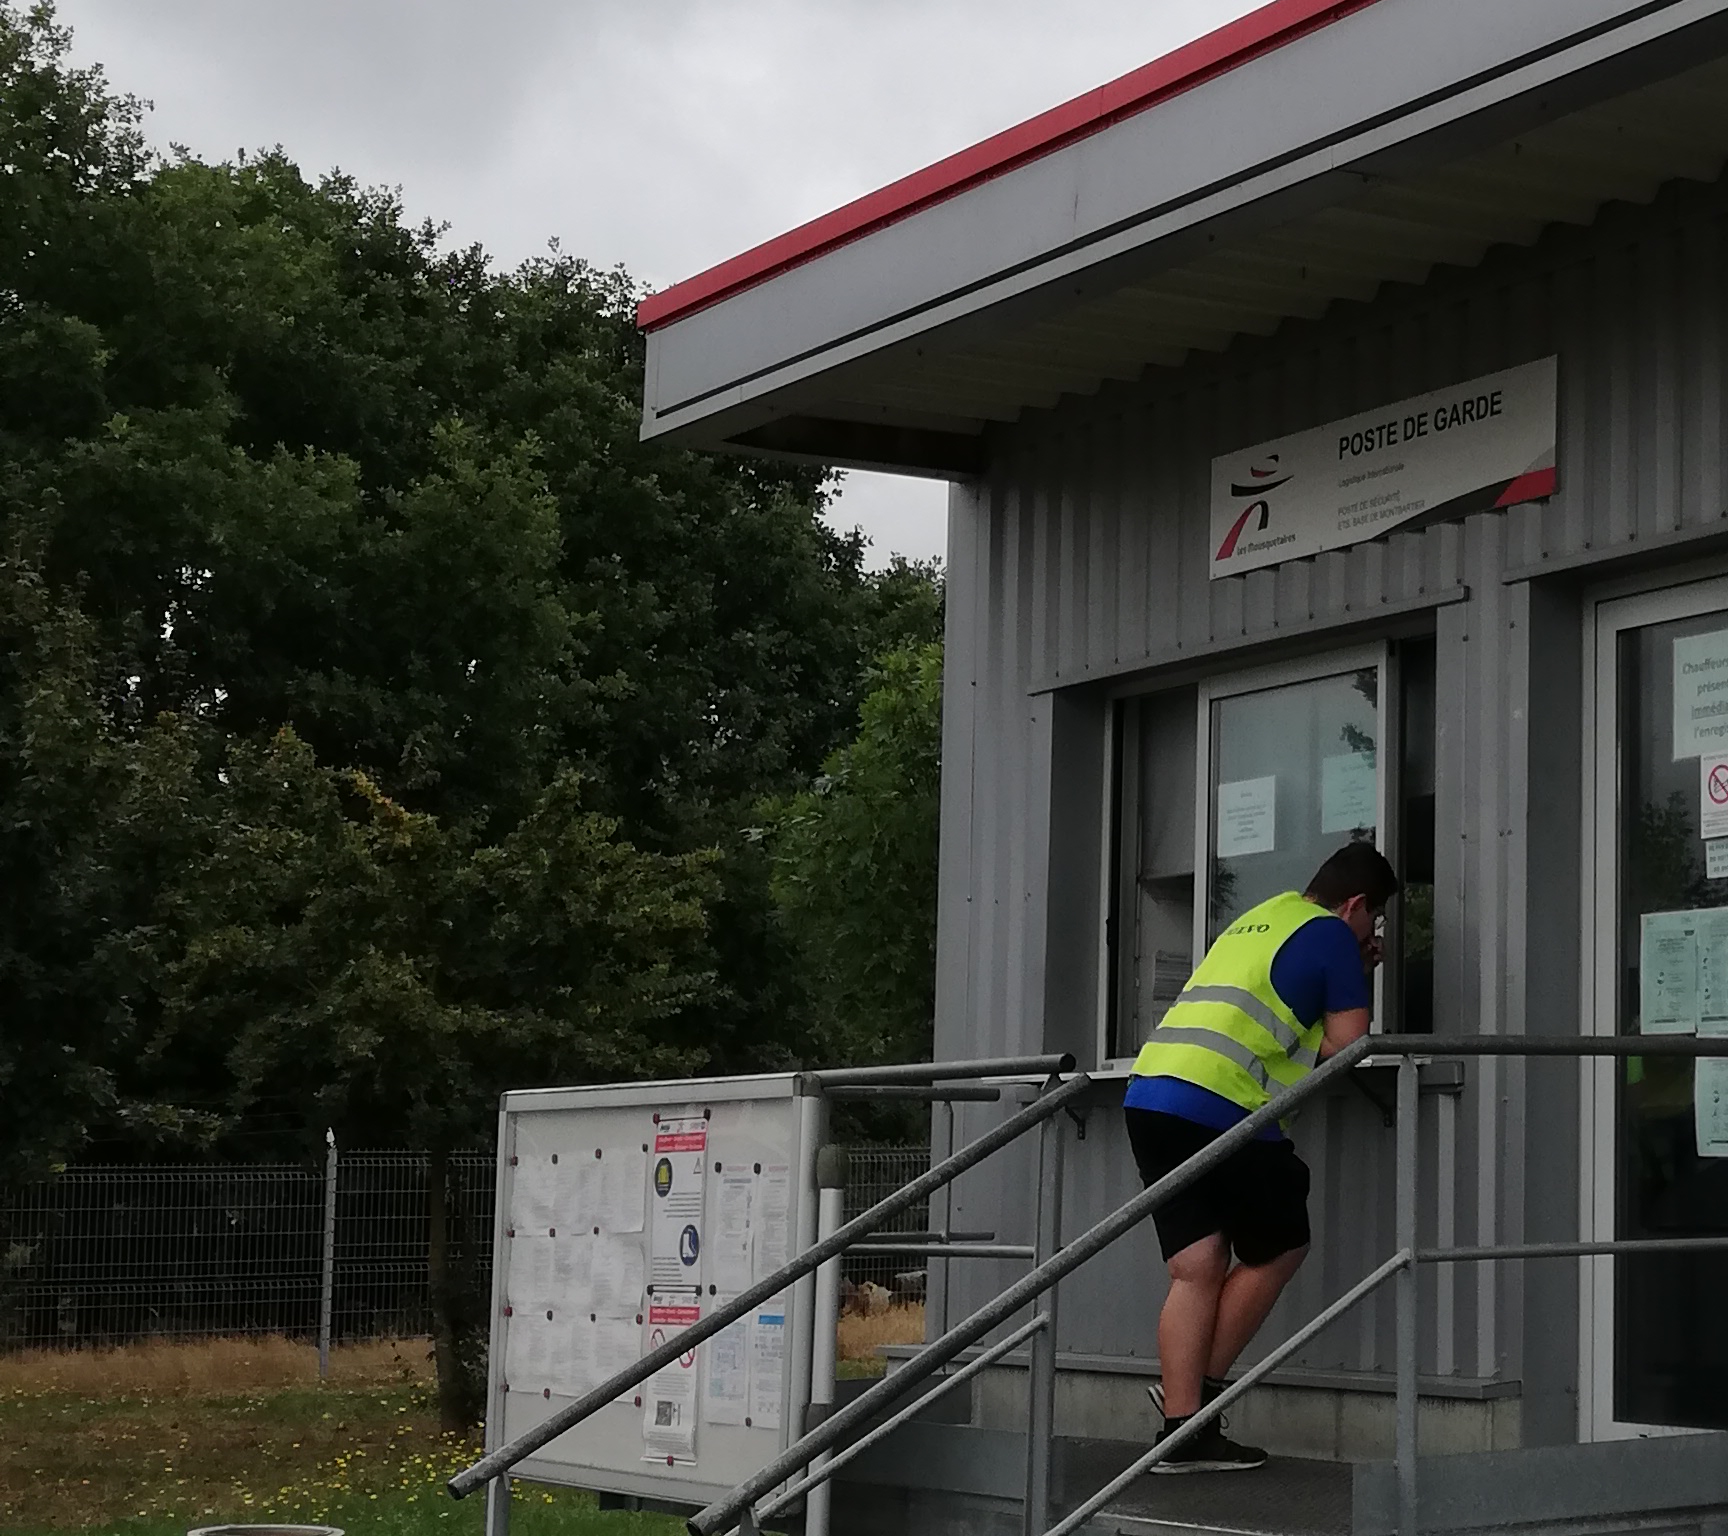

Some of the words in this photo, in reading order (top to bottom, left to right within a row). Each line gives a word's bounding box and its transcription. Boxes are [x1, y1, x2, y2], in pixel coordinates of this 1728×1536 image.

[1339, 421, 1398, 460] POSTE
[1403, 412, 1428, 441] DE
[1434, 390, 1502, 431] GARDE
